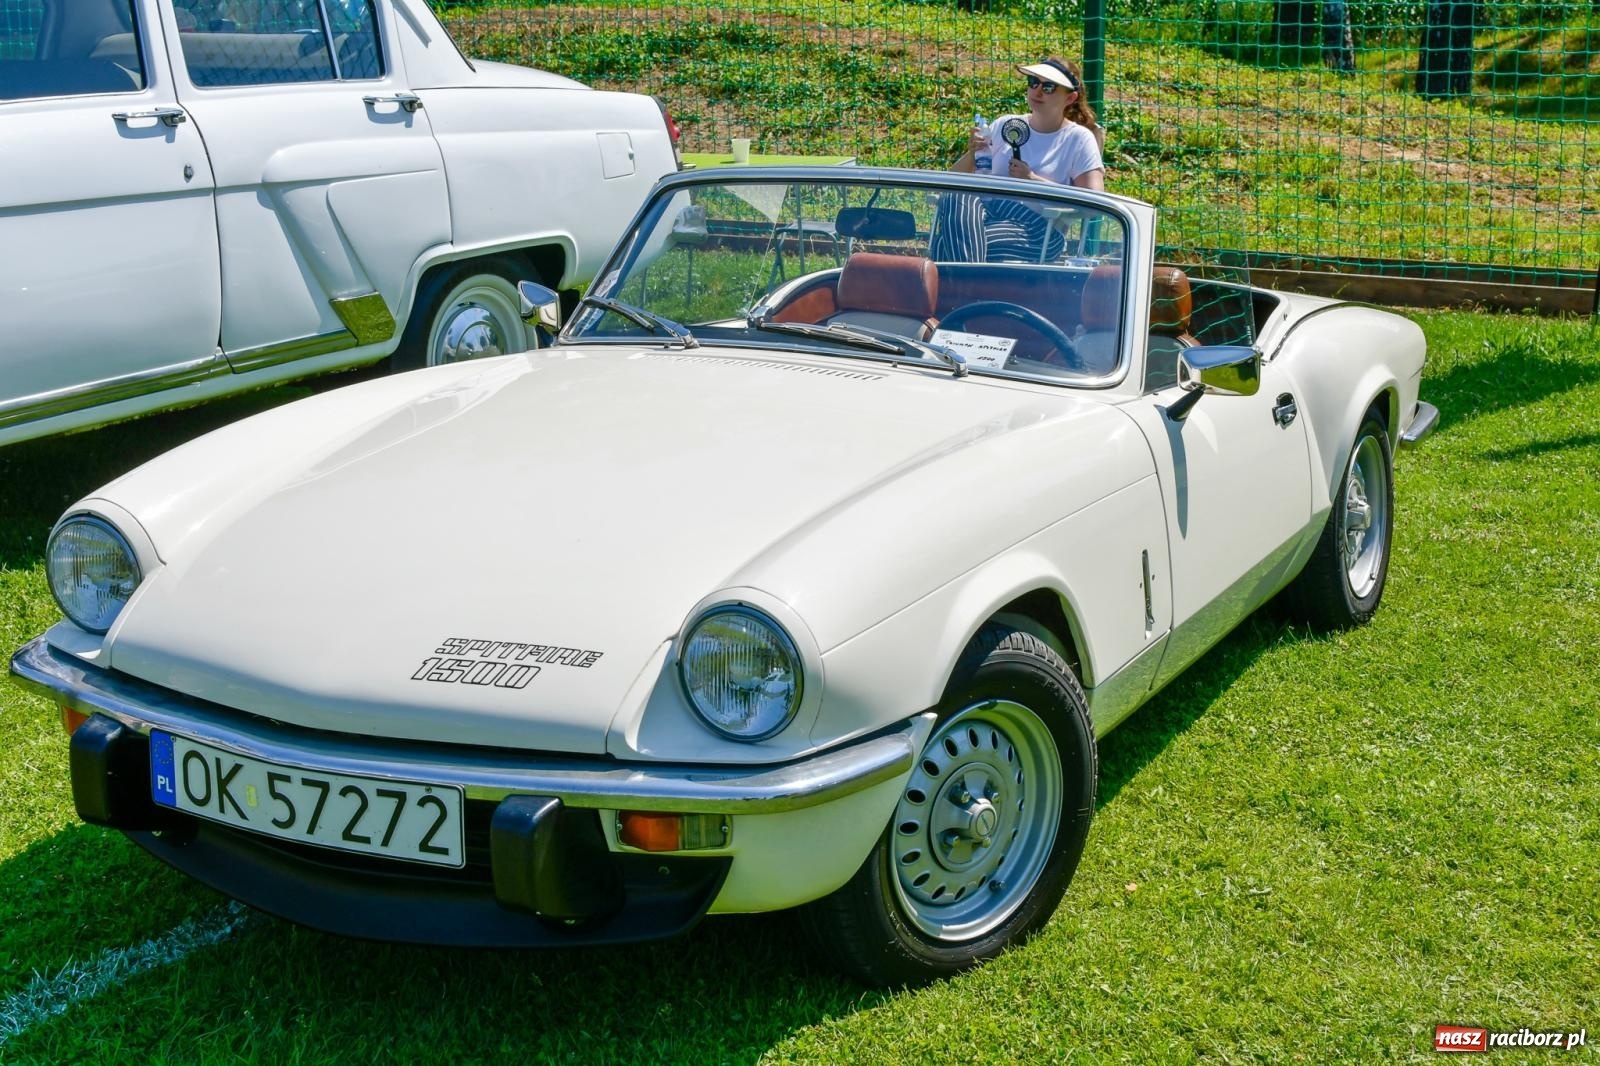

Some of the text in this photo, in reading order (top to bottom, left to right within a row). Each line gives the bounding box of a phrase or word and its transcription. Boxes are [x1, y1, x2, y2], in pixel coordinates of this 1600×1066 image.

[435, 637, 604, 668] SPITFIRE
[410, 657, 541, 689] 1500
[157, 774, 174, 793] PL
[182, 749, 450, 856] OK 57272
